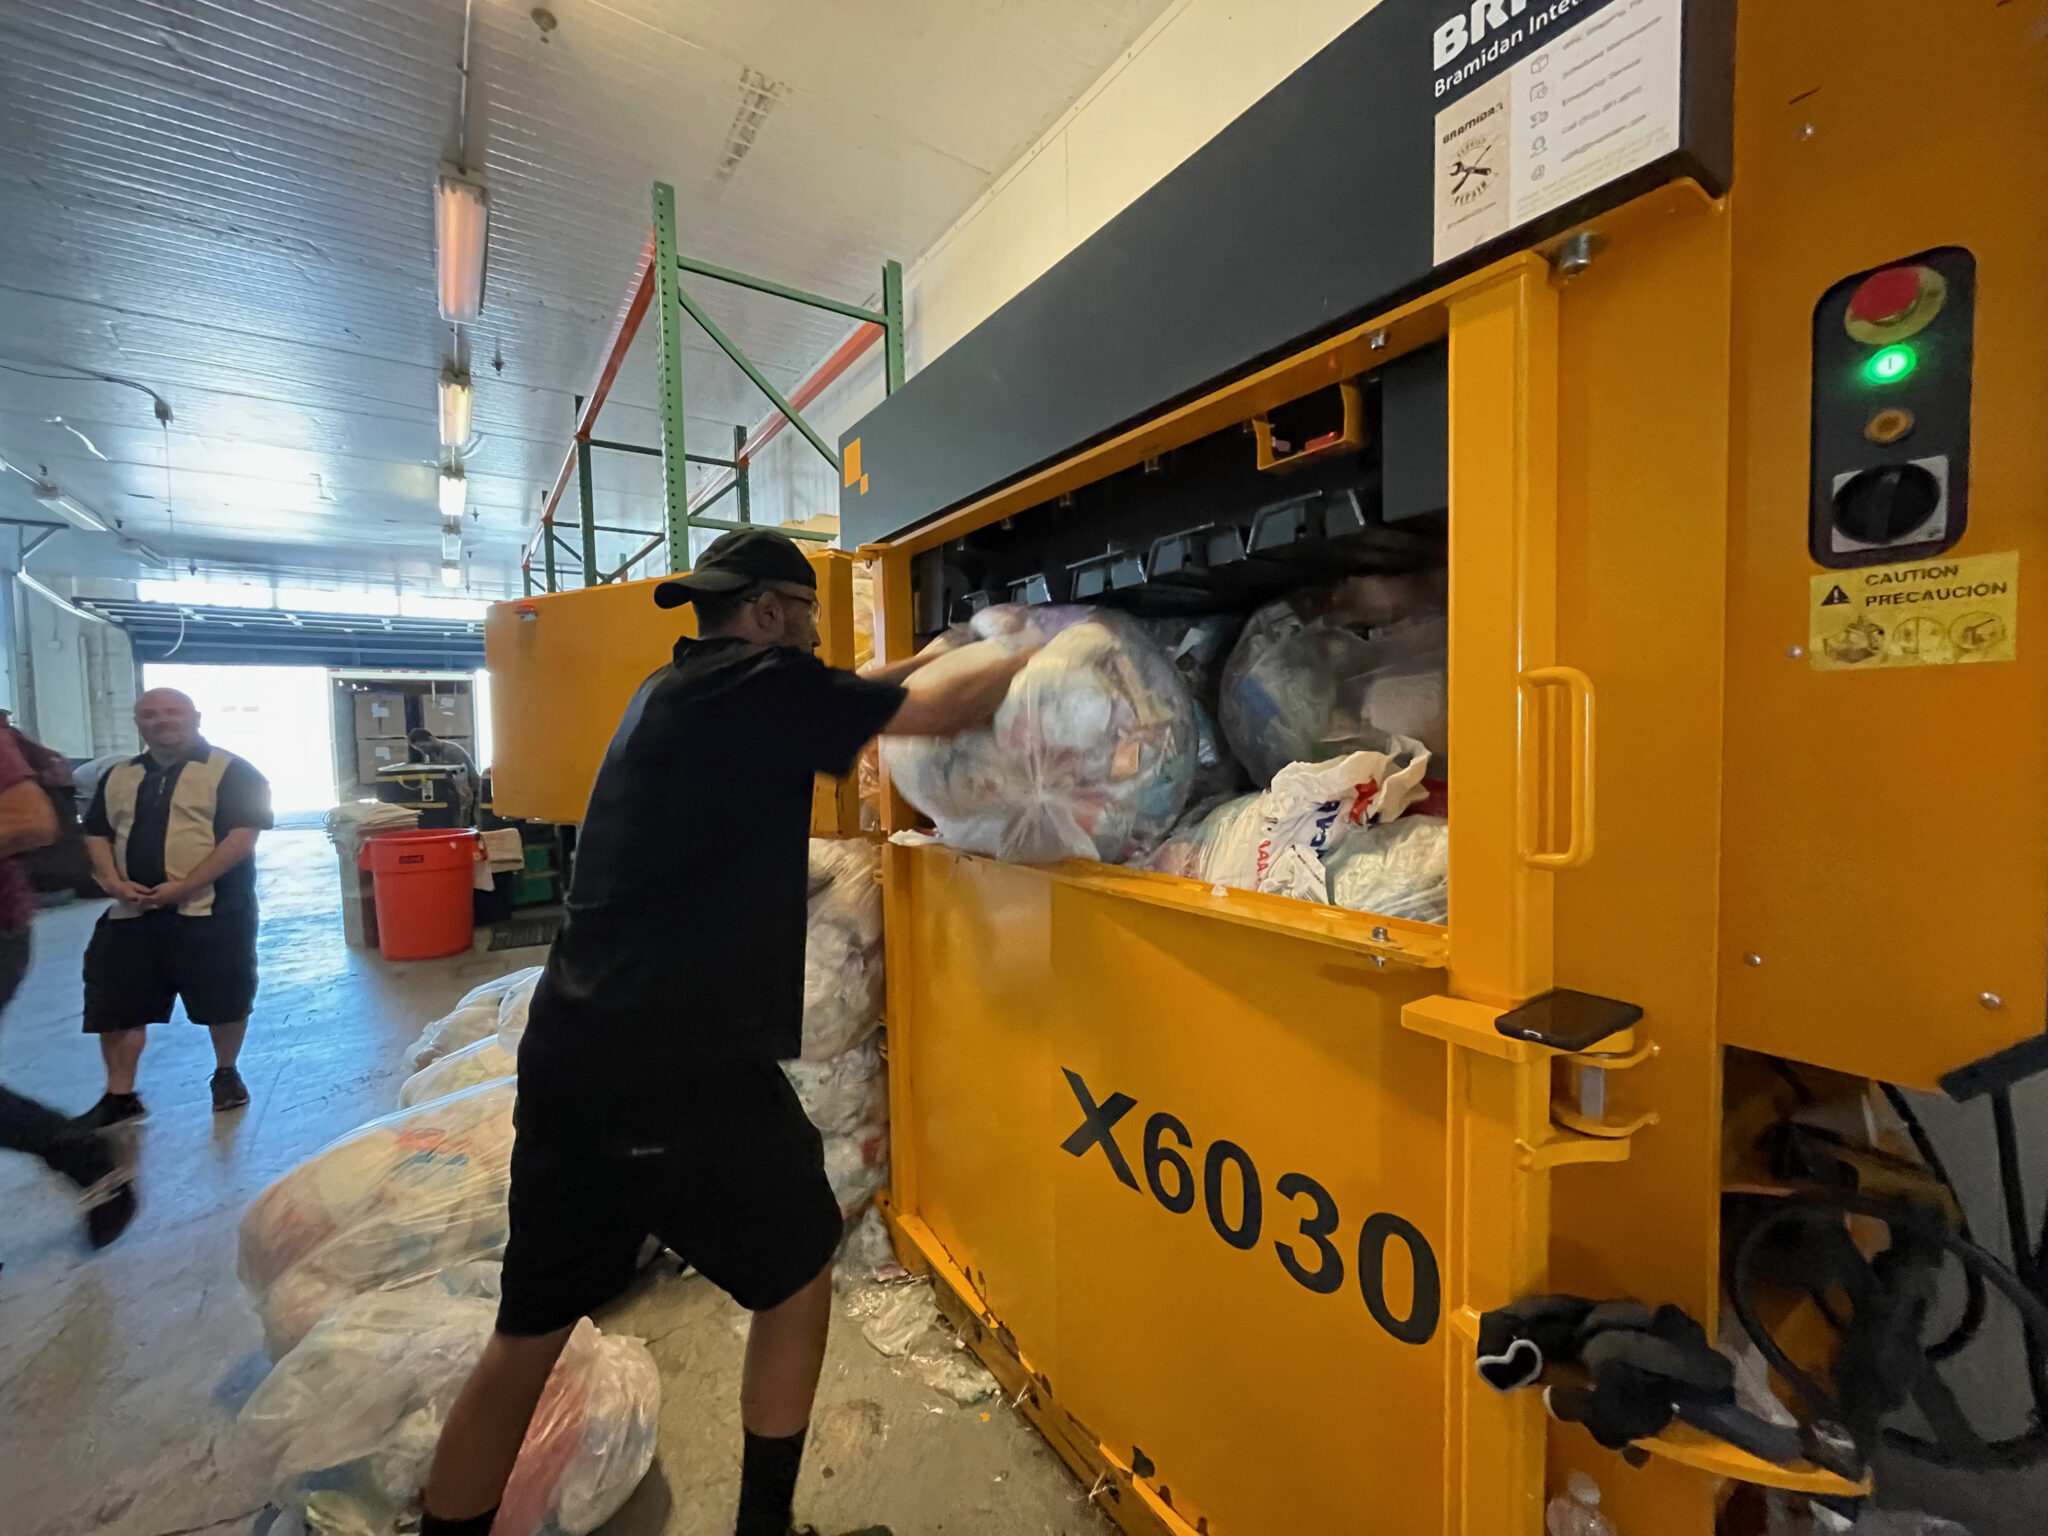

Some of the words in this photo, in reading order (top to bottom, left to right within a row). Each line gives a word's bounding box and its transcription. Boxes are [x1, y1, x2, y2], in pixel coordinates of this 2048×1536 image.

[1434, 29, 1523, 98] Bramidan
[1865, 564, 1960, 586] CAUTION
[1865, 581, 2008, 607] PRECAUCION
[1060, 1066, 1441, 1345] X6030
